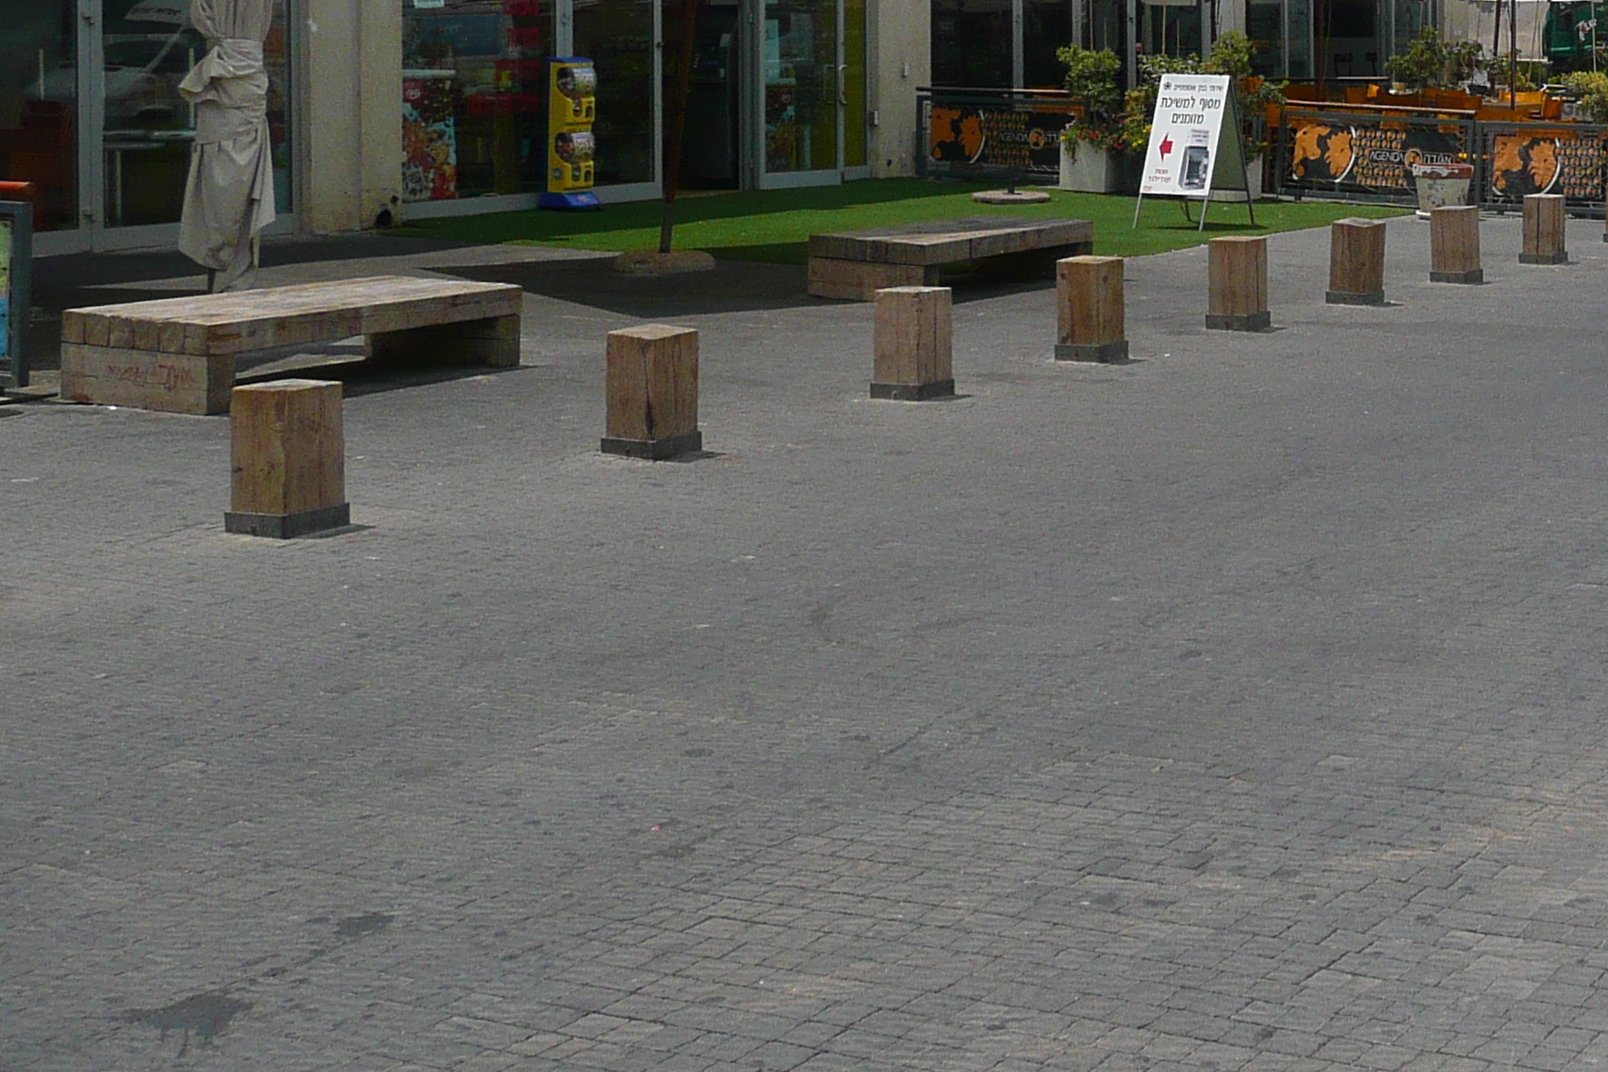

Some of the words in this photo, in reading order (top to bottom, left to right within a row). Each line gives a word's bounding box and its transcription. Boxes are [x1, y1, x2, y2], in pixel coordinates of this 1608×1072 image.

[1159, 95, 1196, 109] למשיכת
[1199, 98, 1221, 112] מסוף
[1171, 113, 1204, 125] מזומנים
[1369, 150, 1405, 162] AGENDA
